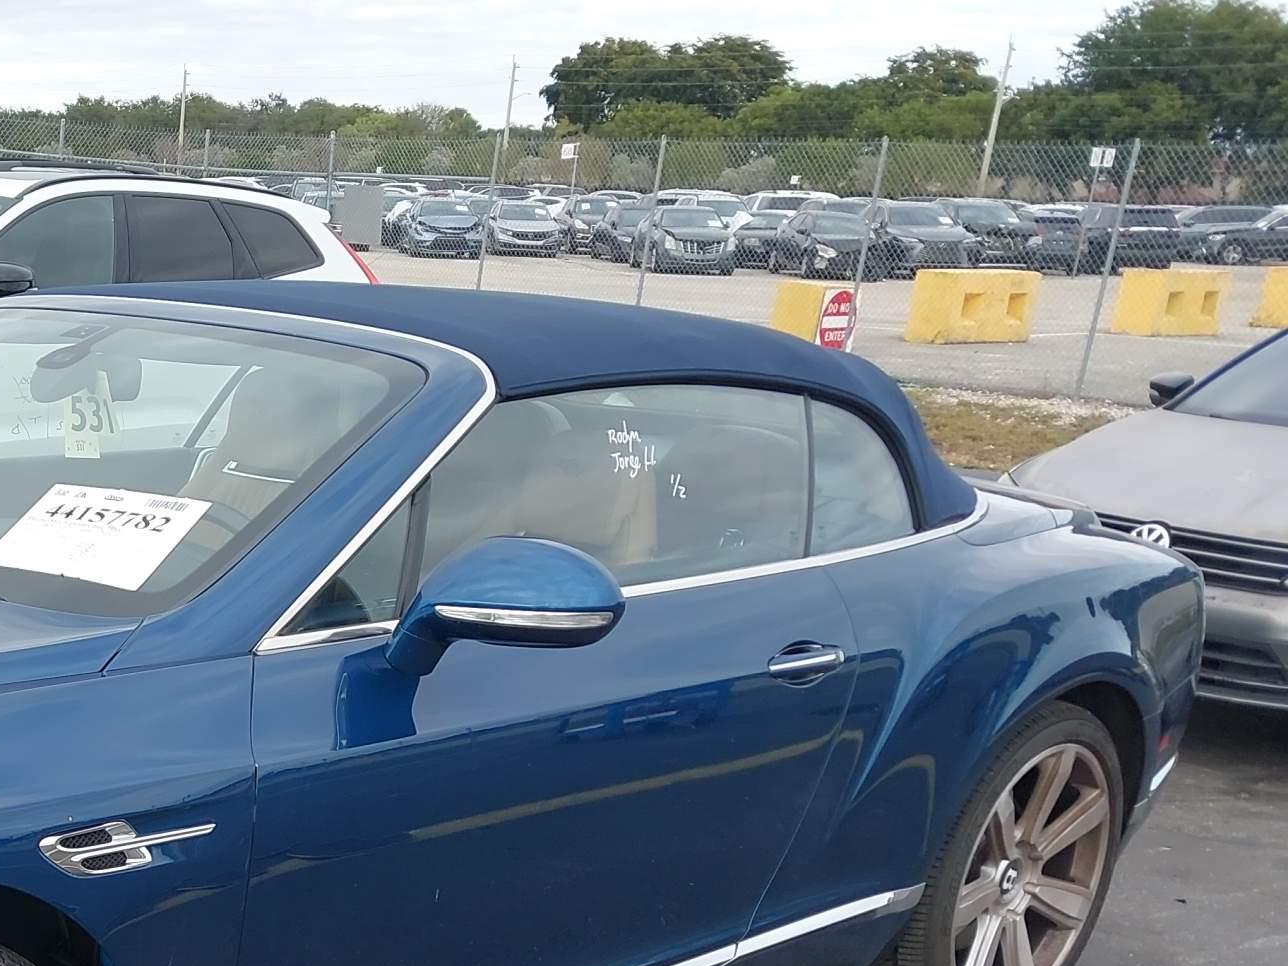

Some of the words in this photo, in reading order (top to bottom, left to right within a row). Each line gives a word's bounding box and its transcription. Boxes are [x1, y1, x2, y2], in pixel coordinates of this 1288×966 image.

[827, 303, 839, 314] DO
[71, 395, 114, 434] 531
[670, 474, 687, 498] 1/2
[45, 503, 172, 533] 44157782
